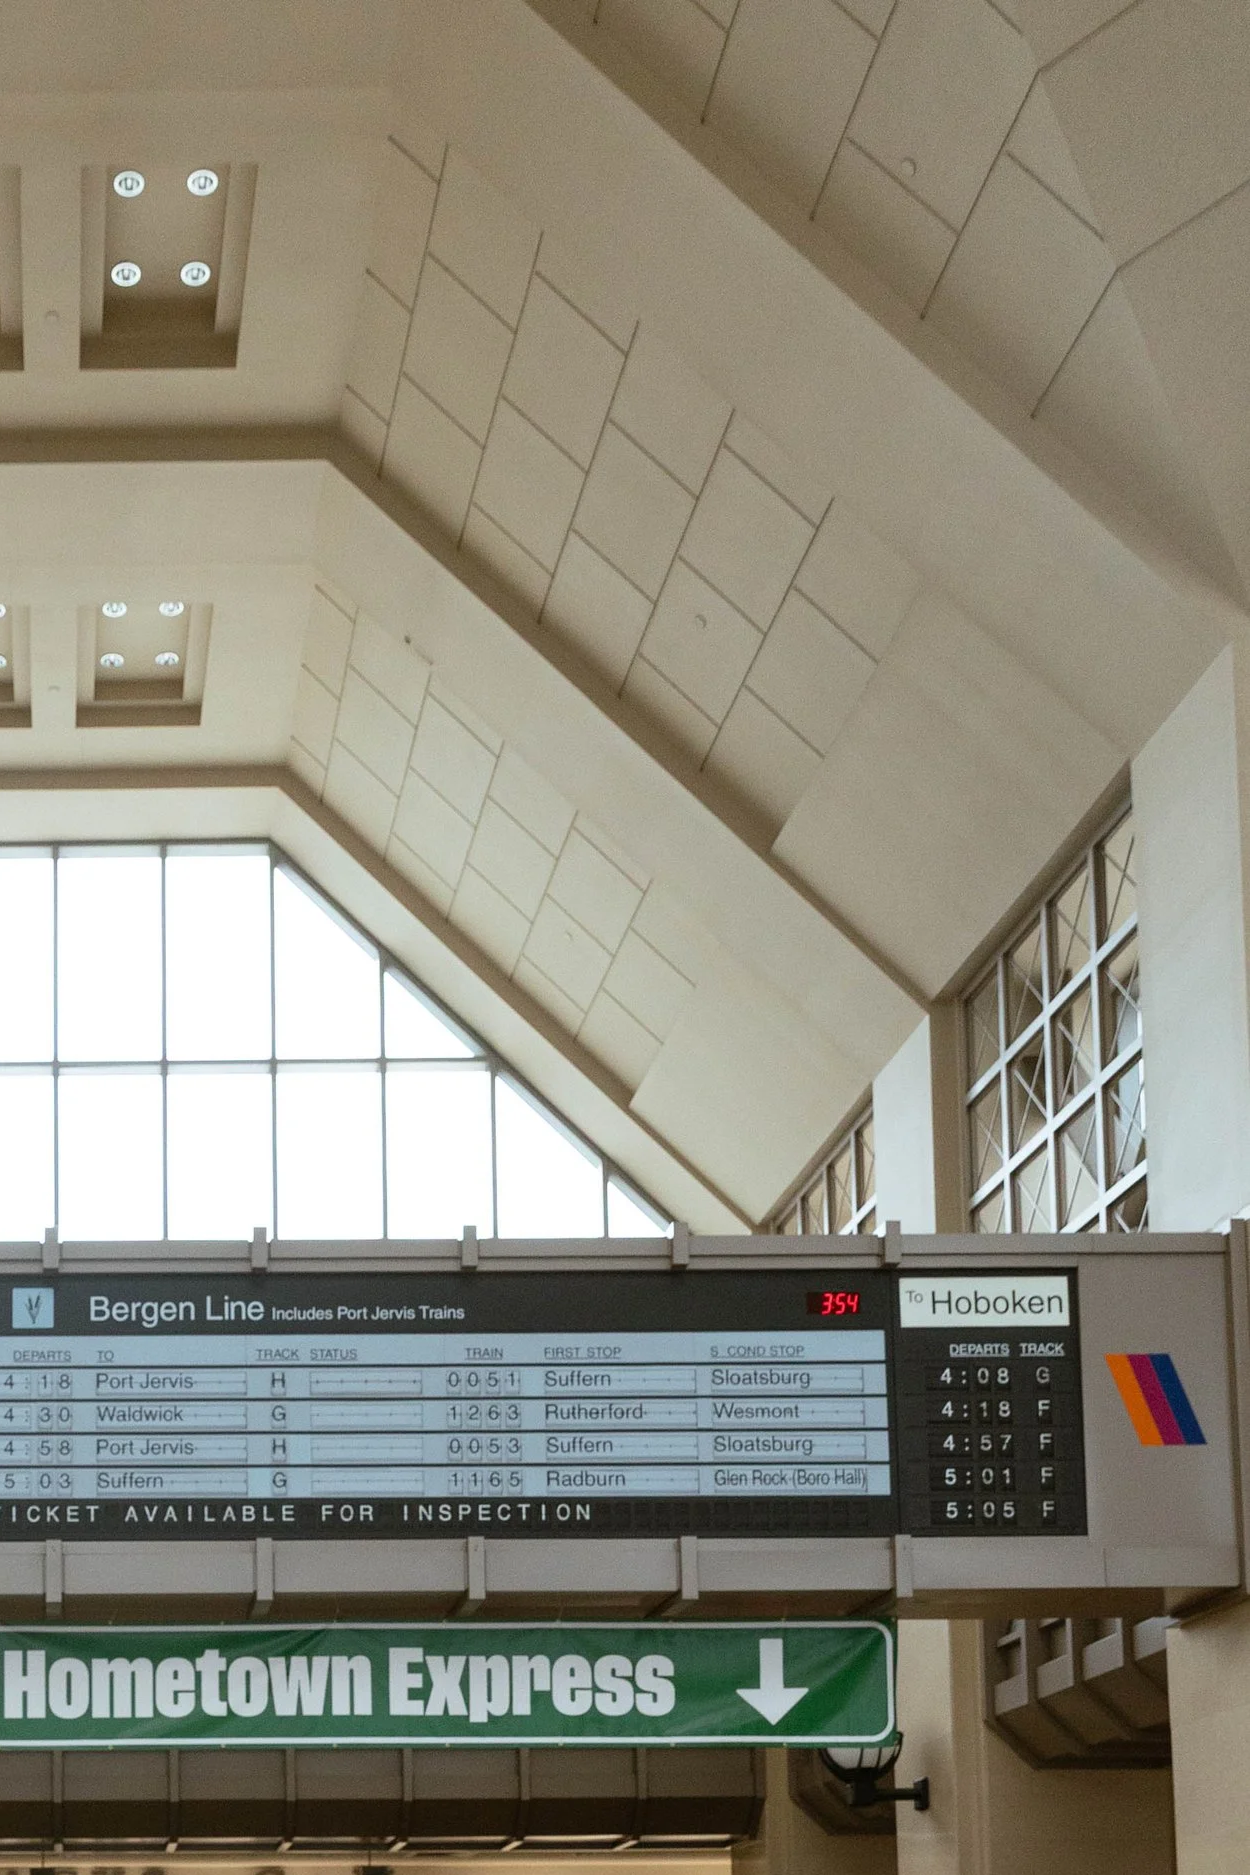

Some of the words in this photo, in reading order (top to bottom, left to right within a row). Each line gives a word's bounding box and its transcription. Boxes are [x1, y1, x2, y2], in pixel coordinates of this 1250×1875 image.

[905, 1290, 923, 1304] To
[932, 1290, 1064, 1315] Hoboken
[90, 1296, 195, 1328] Bergen
[206, 1295, 265, 1320] Line
[272, 1306, 333, 1320] Includes
[337, 1306, 367, 1320] Port
[371, 1305, 415, 1320] Jervis
[419, 1305, 465, 1319] Trains
[13, 1351, 72, 1362] DEPARTS
[97, 1351, 114, 1362] TO
[255, 1349, 299, 1361] TRACK
[310, 1349, 358, 1360] STATUS
[465, 1348, 503, 1359] TRAIN
[544, 1347, 581, 1359] FIRST
[587, 1347, 622, 1358] STOP
[770, 1345, 805, 1357] STOP
[949, 1344, 1010, 1357] DEPARTS
[1019, 1343, 1065, 1356] TRACK
[96, 1374, 133, 1388] Port
[140, 1374, 194, 1388] Jervis
[271, 1372, 286, 1388] H
[448, 1372, 515, 1387] 0051
[545, 1370, 611, 1386] Suffern
[711, 1369, 811, 1388] Sloatsburg
[940, 1368, 1010, 1384] 4:08
[1036, 1367, 1051, 1384] G
[98, 1406, 183, 1422] Waldwick
[271, 1406, 286, 1421] G
[450, 1405, 519, 1421] 1263
[545, 1404, 644, 1419] Rutherford
[713, 1402, 799, 1419] Wesmont
[942, 1401, 1011, 1417] 4:18
[1039, 1400, 1051, 1416] F
[96, 1439, 134, 1455] Port
[140, 1439, 194, 1455] Jervis
[272, 1438, 286, 1454] H
[450, 1438, 519, 1454] 0053
[546, 1437, 613, 1453] Suffern
[713, 1436, 813, 1455] Sloatsburg
[943, 1434, 1012, 1451] 4:57
[1040, 1433, 1052, 1449] F
[98, 1473, 163, 1488] Suffern
[272, 1472, 287, 1488] G
[451, 1472, 520, 1487] 1165
[547, 1471, 626, 1487] Radburn
[714, 1469, 748, 1486] Glen
[752, 1469, 788, 1485] Rock
[792, 1469, 830, 1488] (Boro
[834, 1468, 867, 1487] Hall)
[945, 1468, 1011, 1485] 5:01
[1041, 1467, 1053, 1483] F
[125, 1505, 295, 1523] AVAILABLE
[321, 1505, 374, 1521] FOR
[403, 1503, 591, 1521] INSPECTION
[946, 1502, 1015, 1518] 5:05
[1043, 1500, 1055, 1517] F
[4, 1649, 372, 1720] Hometown
[388, 1646, 675, 1722] Express
